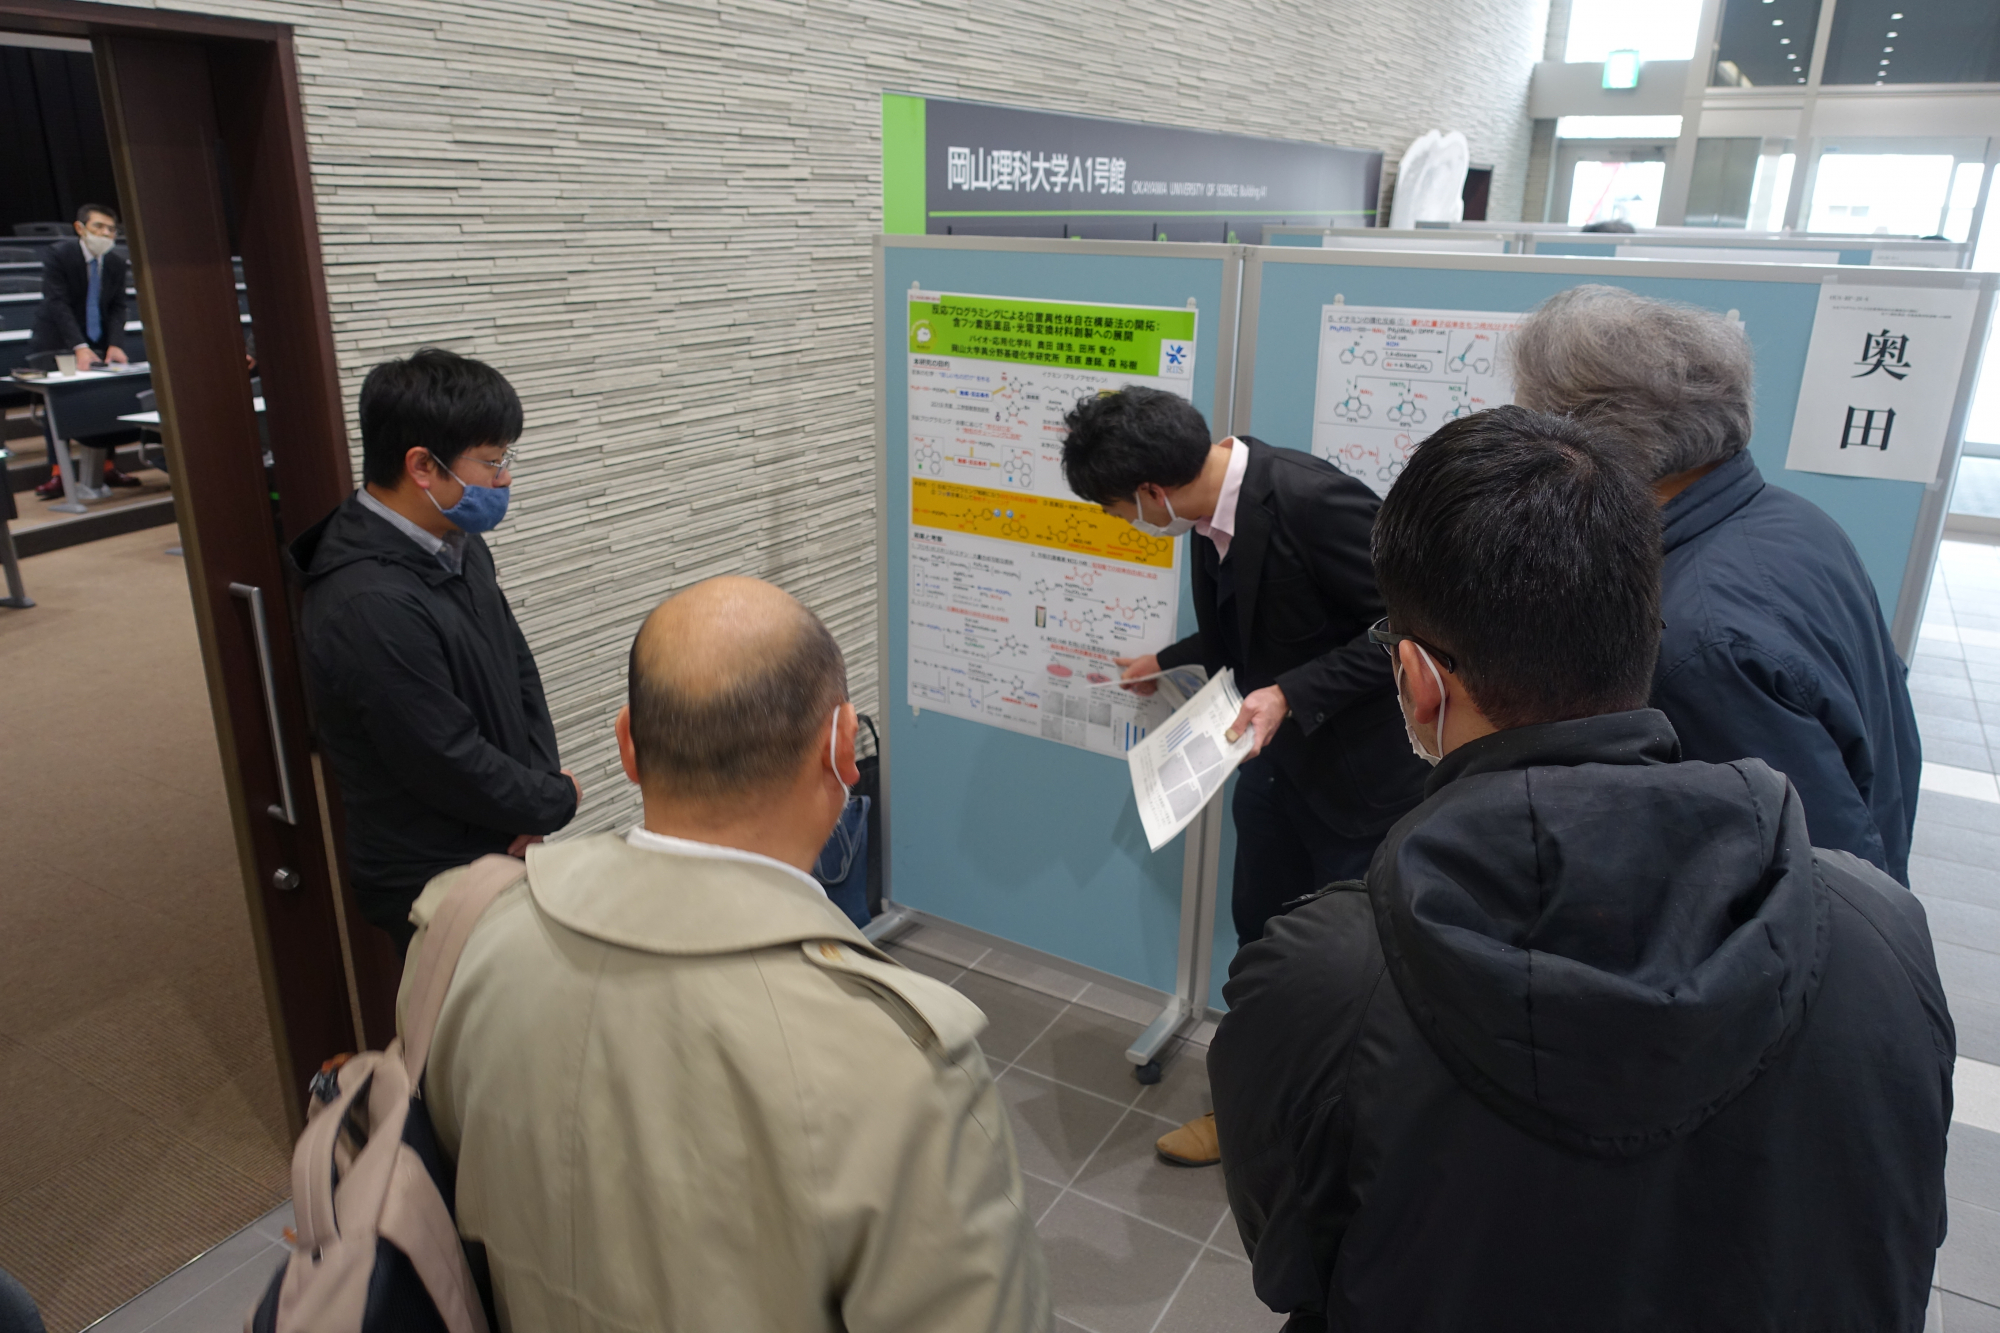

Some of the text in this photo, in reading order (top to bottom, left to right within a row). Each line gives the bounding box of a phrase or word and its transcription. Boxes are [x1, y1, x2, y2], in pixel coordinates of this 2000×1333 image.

[948, 146, 1126, 195] 岡山理科大学A1号館
[1131, 180, 1168, 195] OKAYAMA
[1169, 182, 1206, 196] UNIVERSITY
[1206, 183, 1216, 196] OF
[1216, 184, 1239, 197] SCIENCE
[1840, 328, 1911, 451] 奥田
